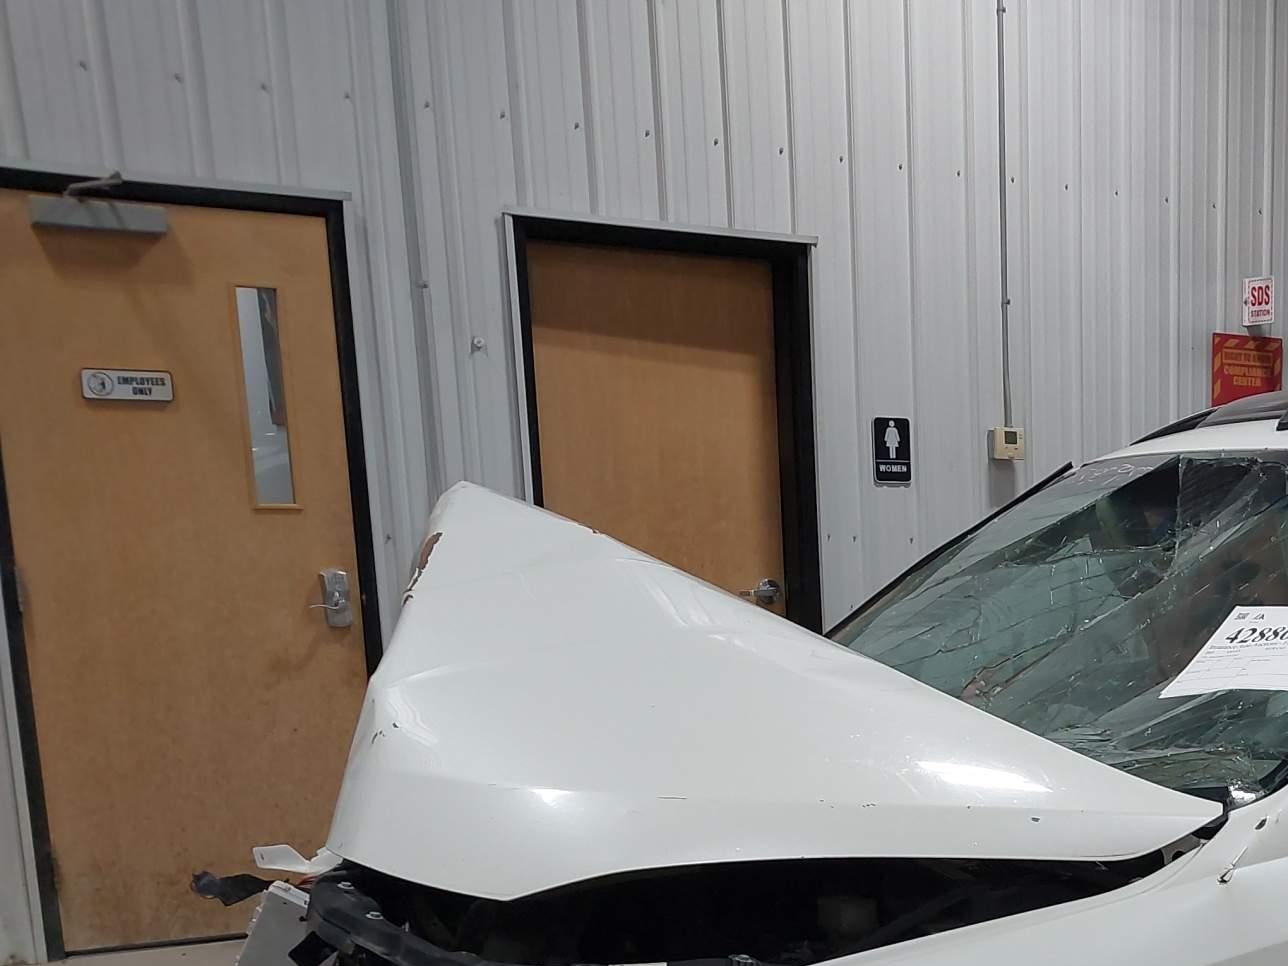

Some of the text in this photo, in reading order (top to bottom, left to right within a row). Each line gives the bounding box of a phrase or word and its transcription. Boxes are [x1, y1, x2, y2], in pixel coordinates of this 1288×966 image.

[1250, 284, 1270, 307] SDS
[1250, 309, 1271, 318] STATION
[117, 376, 166, 386] EMPLOYEES
[132, 386, 152, 396] ONLY
[879, 464, 907, 473] WOMEN
